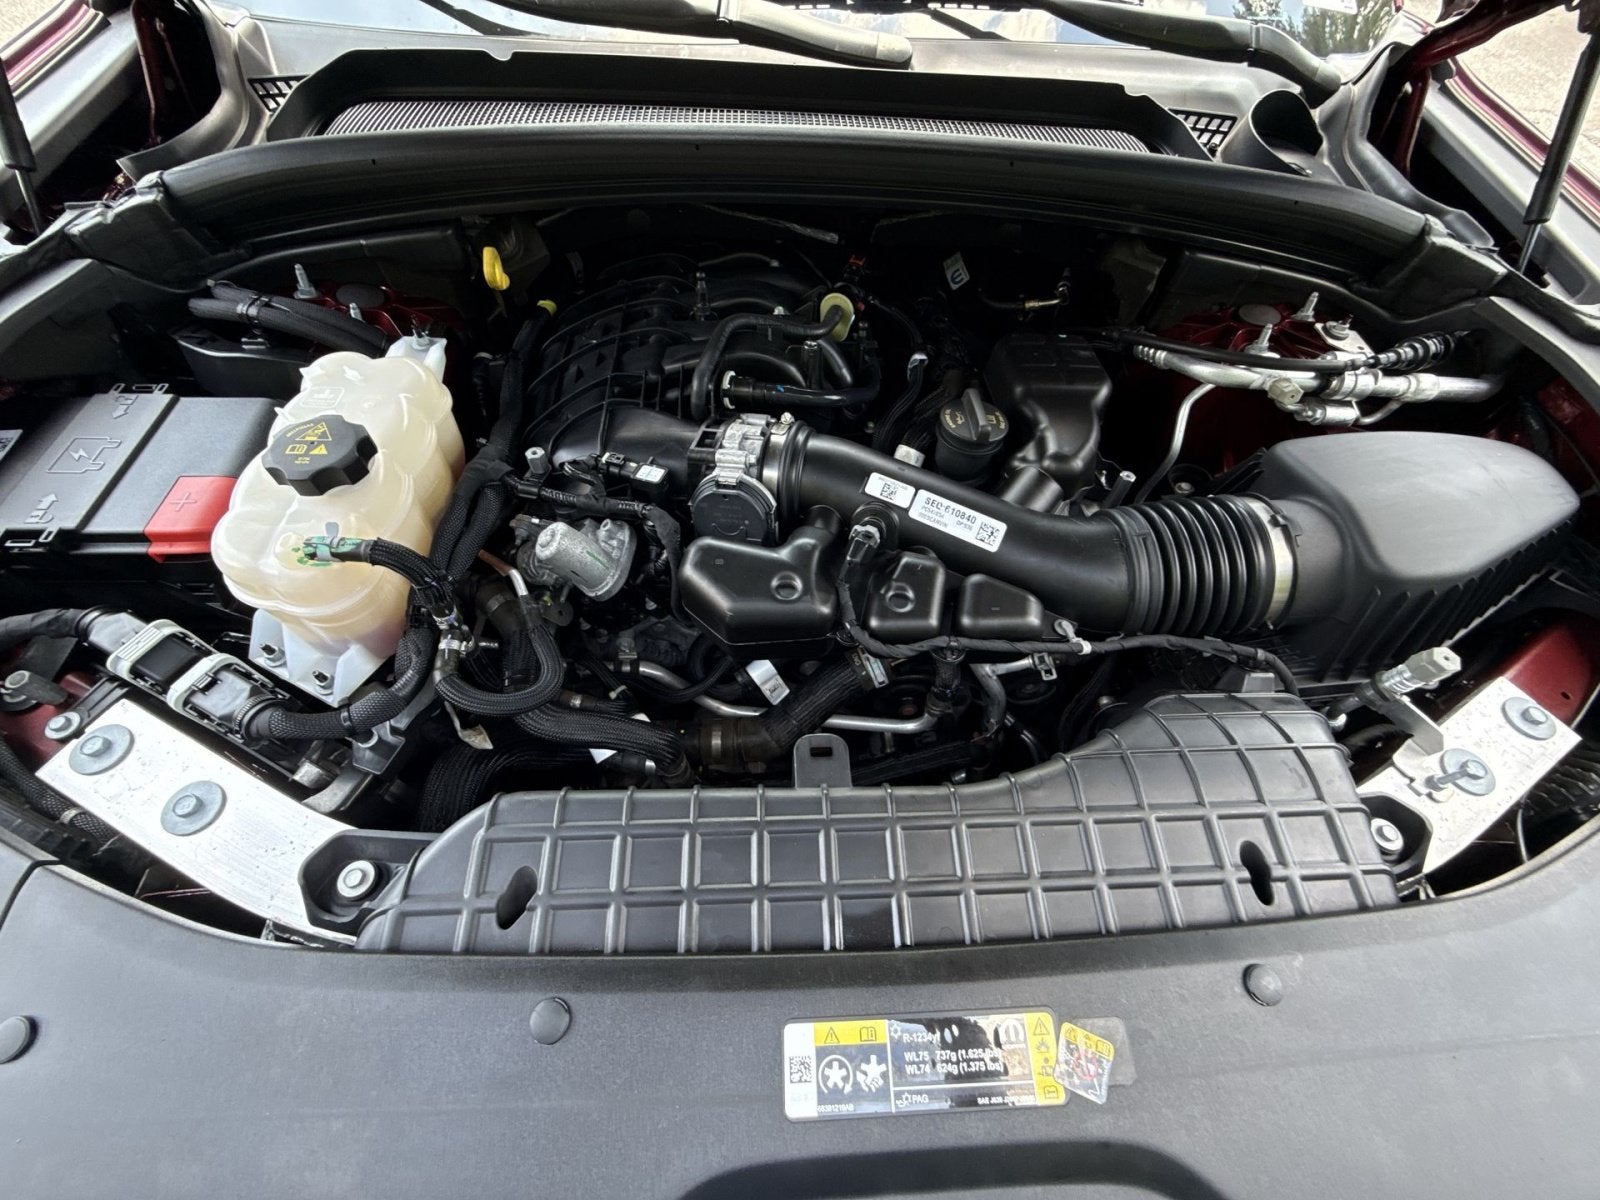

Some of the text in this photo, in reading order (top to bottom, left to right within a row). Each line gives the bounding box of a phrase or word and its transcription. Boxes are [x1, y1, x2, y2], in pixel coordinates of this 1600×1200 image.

[944, 504, 977, 524] 610840
[903, 1031, 941, 1044] R-1234yf
[904, 1051, 930, 1062] WL75
[935, 1050, 957, 1062] 737g
[958, 1048, 984, 1061] (1.625
[905, 1061, 1004, 1075] WL74 624g (1.375 lbs)
[912, 1093, 930, 1104] PAG
